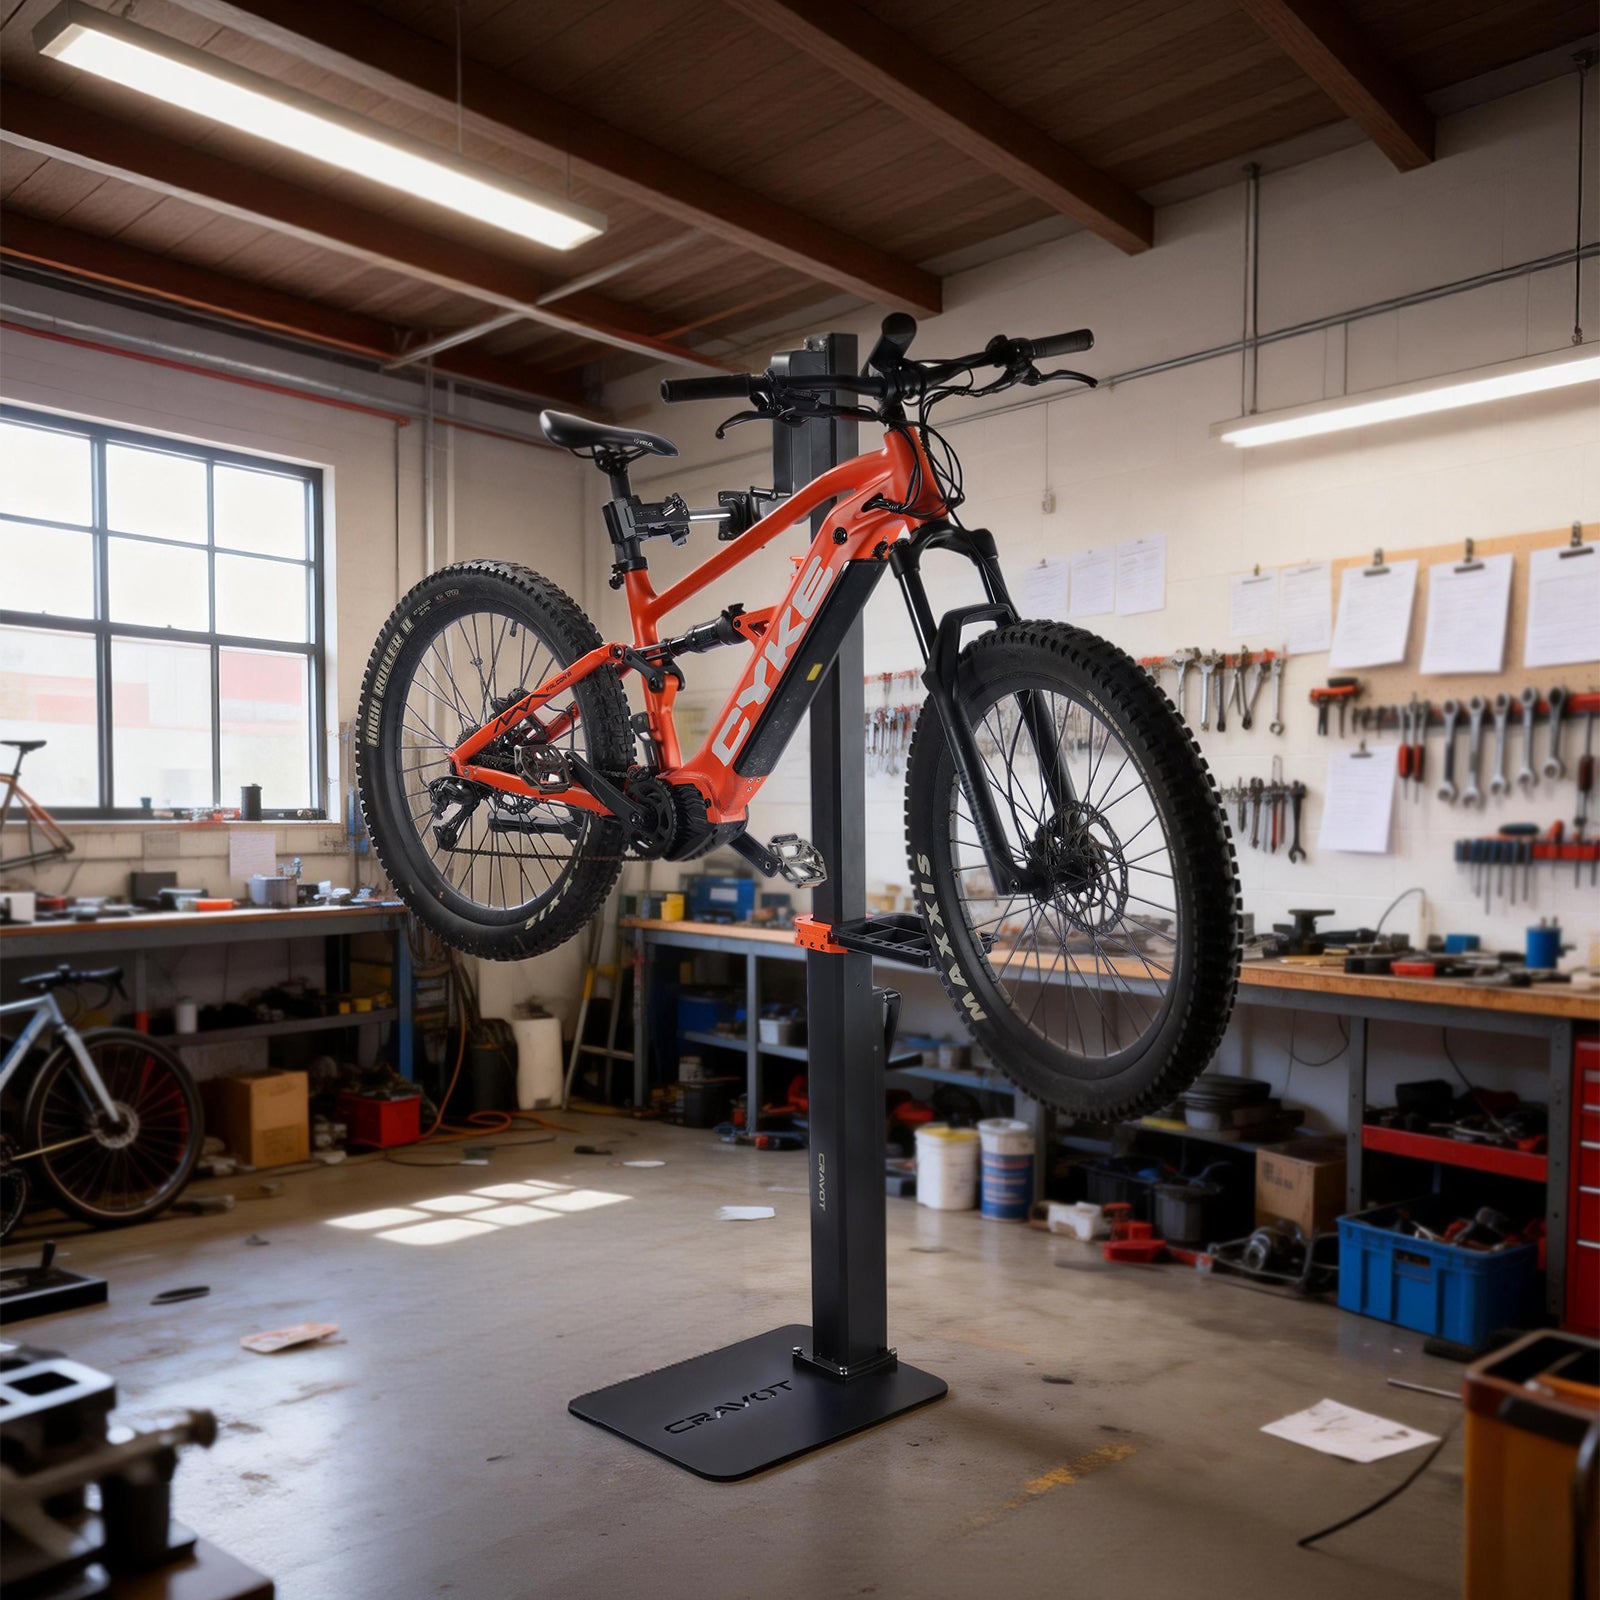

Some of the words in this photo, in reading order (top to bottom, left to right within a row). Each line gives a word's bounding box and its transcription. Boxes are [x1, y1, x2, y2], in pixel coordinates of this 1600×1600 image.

[372, 632, 404, 698] ROLLER
[711, 555, 834, 766] CYKE
[366, 697, 383, 748] HIGH
[917, 853, 988, 1022] MAXXIS
[818, 1152, 826, 1212] CRAVOT
[664, 1380, 793, 1434] CRAVOT
